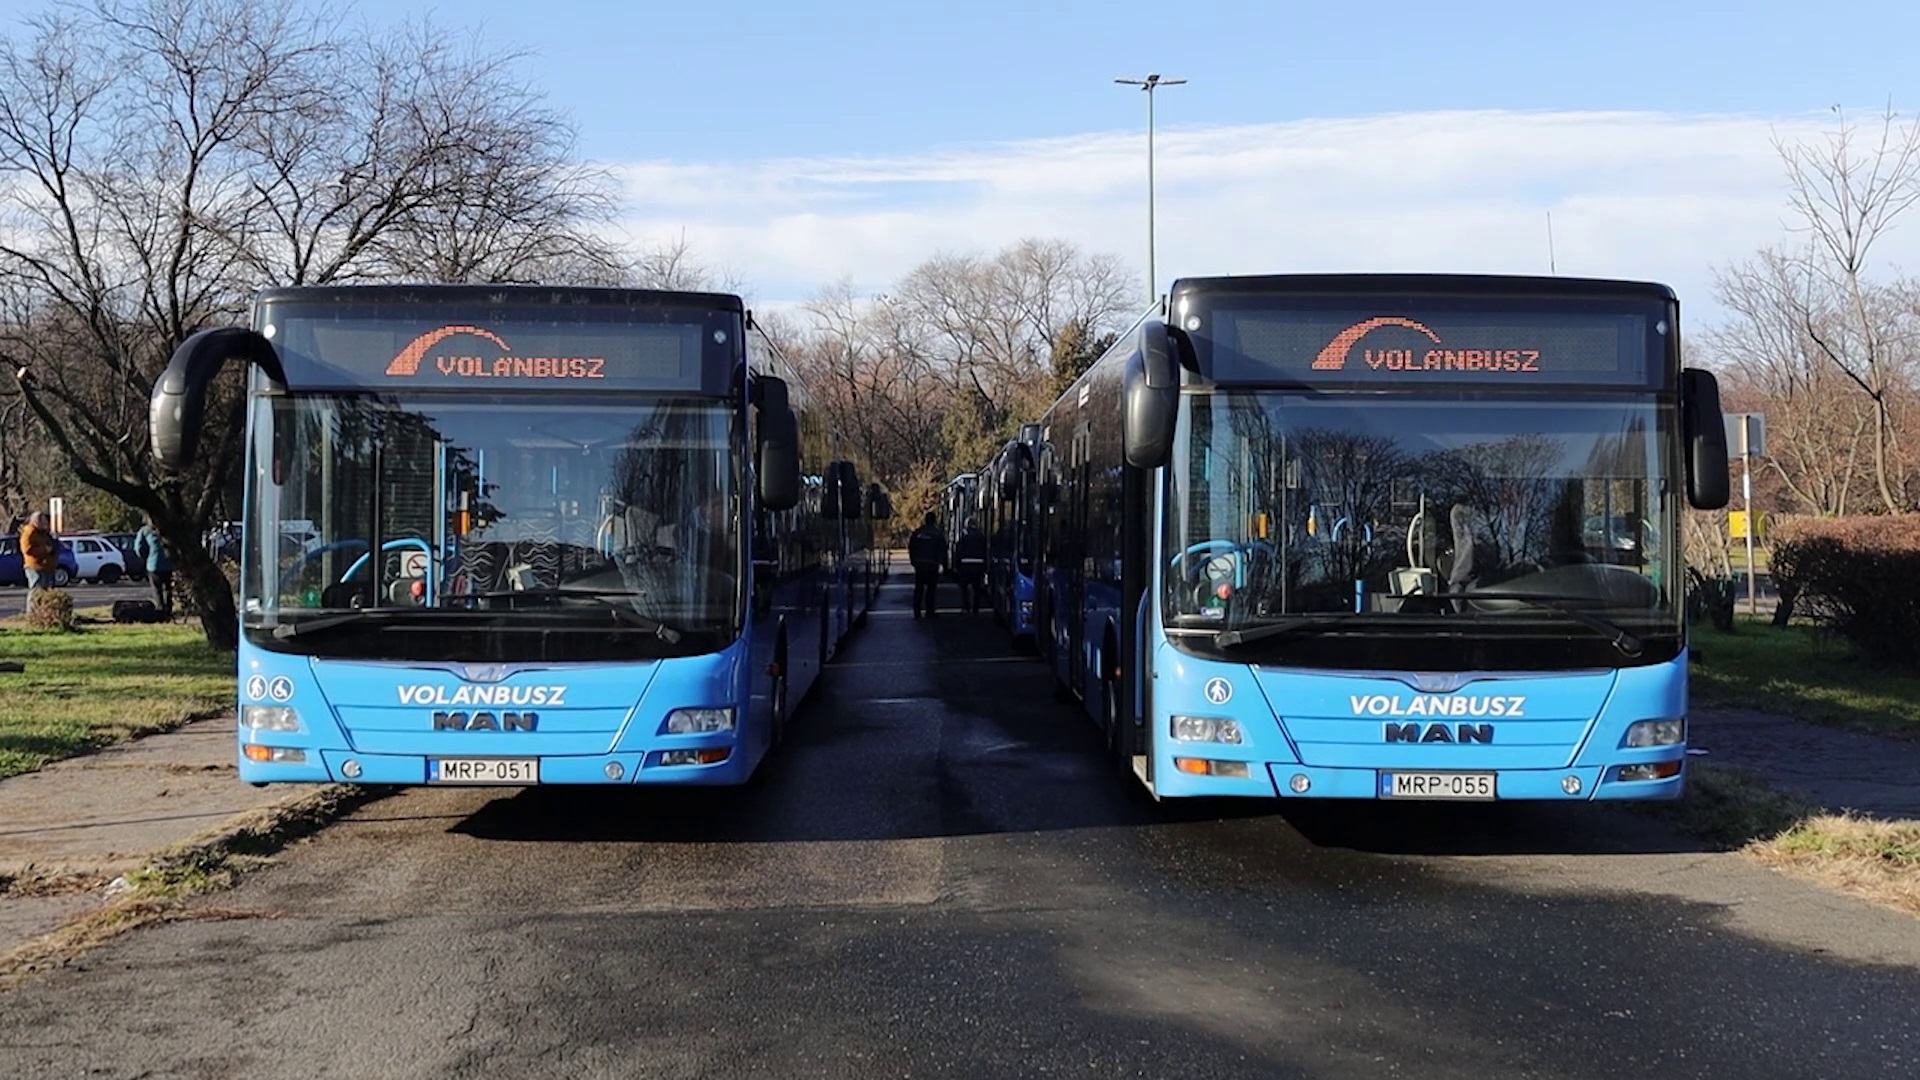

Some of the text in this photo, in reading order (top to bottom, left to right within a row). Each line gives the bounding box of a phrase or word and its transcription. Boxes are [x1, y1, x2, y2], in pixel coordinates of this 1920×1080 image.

[432, 710, 539, 732] MAN
[1382, 720, 1494, 744] MAN
[444, 762, 531, 779] MRP-051
[1397, 776, 1489, 794] MRP-055
